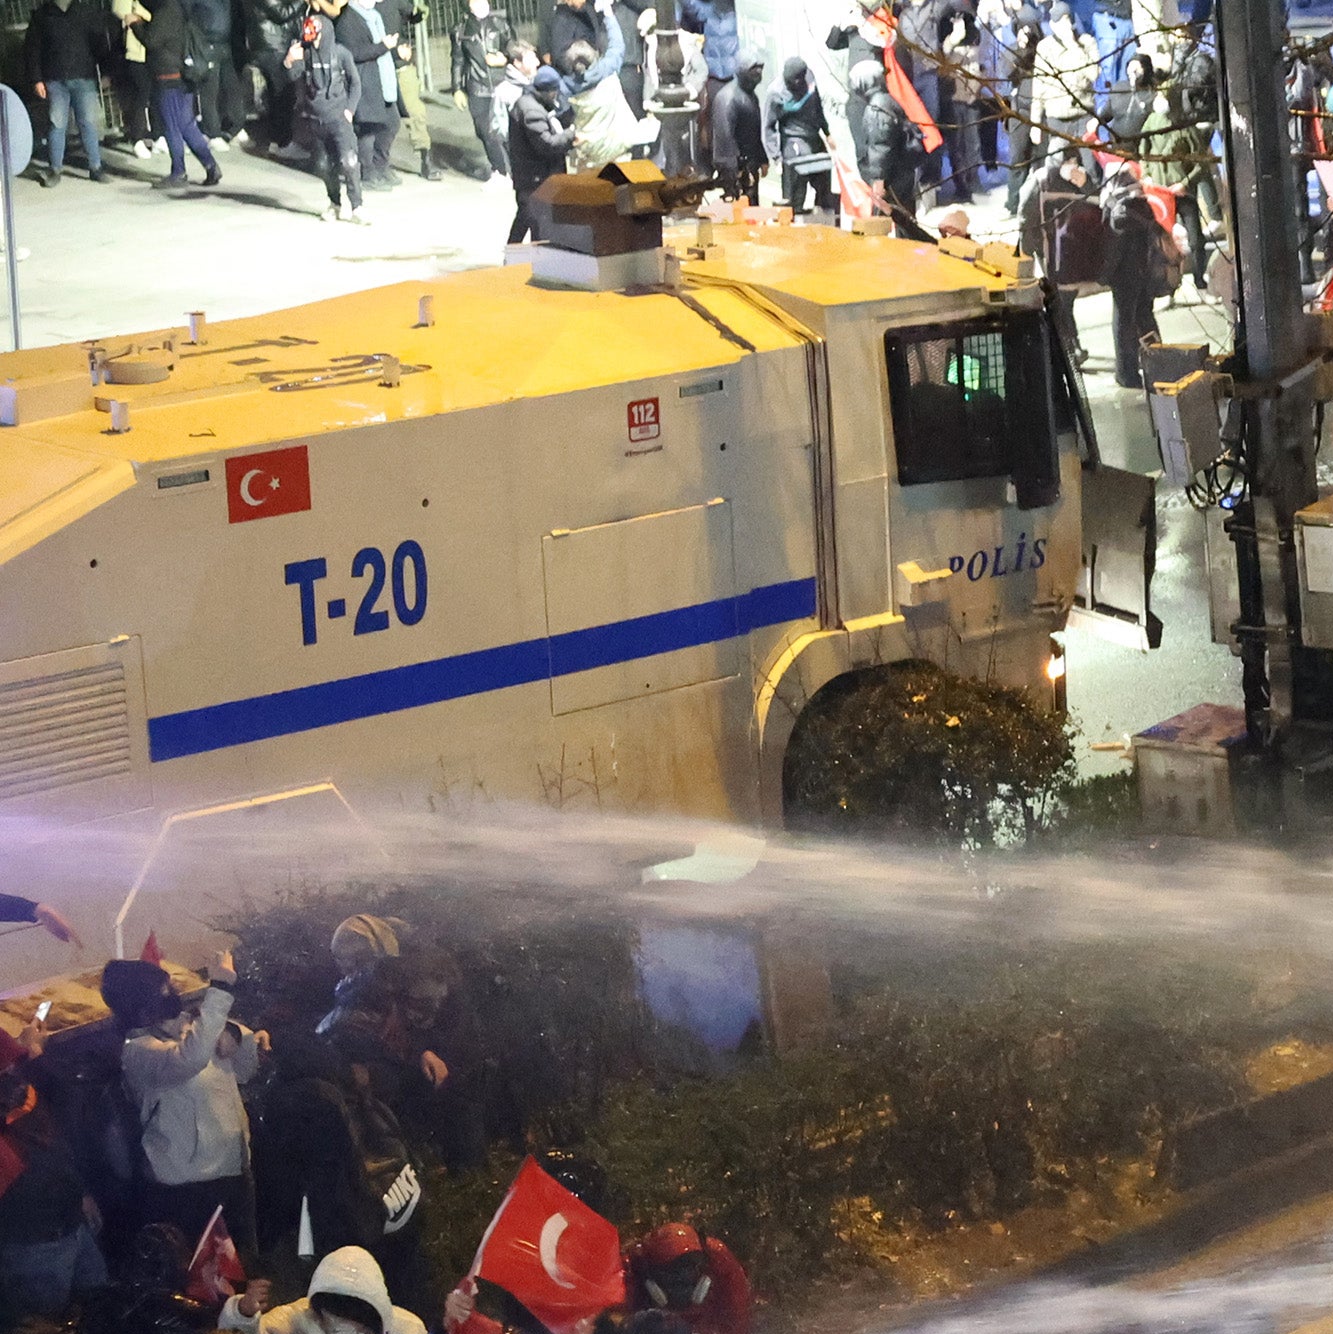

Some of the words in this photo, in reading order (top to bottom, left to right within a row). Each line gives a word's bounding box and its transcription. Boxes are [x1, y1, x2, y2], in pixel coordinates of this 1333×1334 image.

[631, 402, 656, 424] 112
[948, 532, 1047, 582] POLİS
[284, 539, 428, 646] T-20
